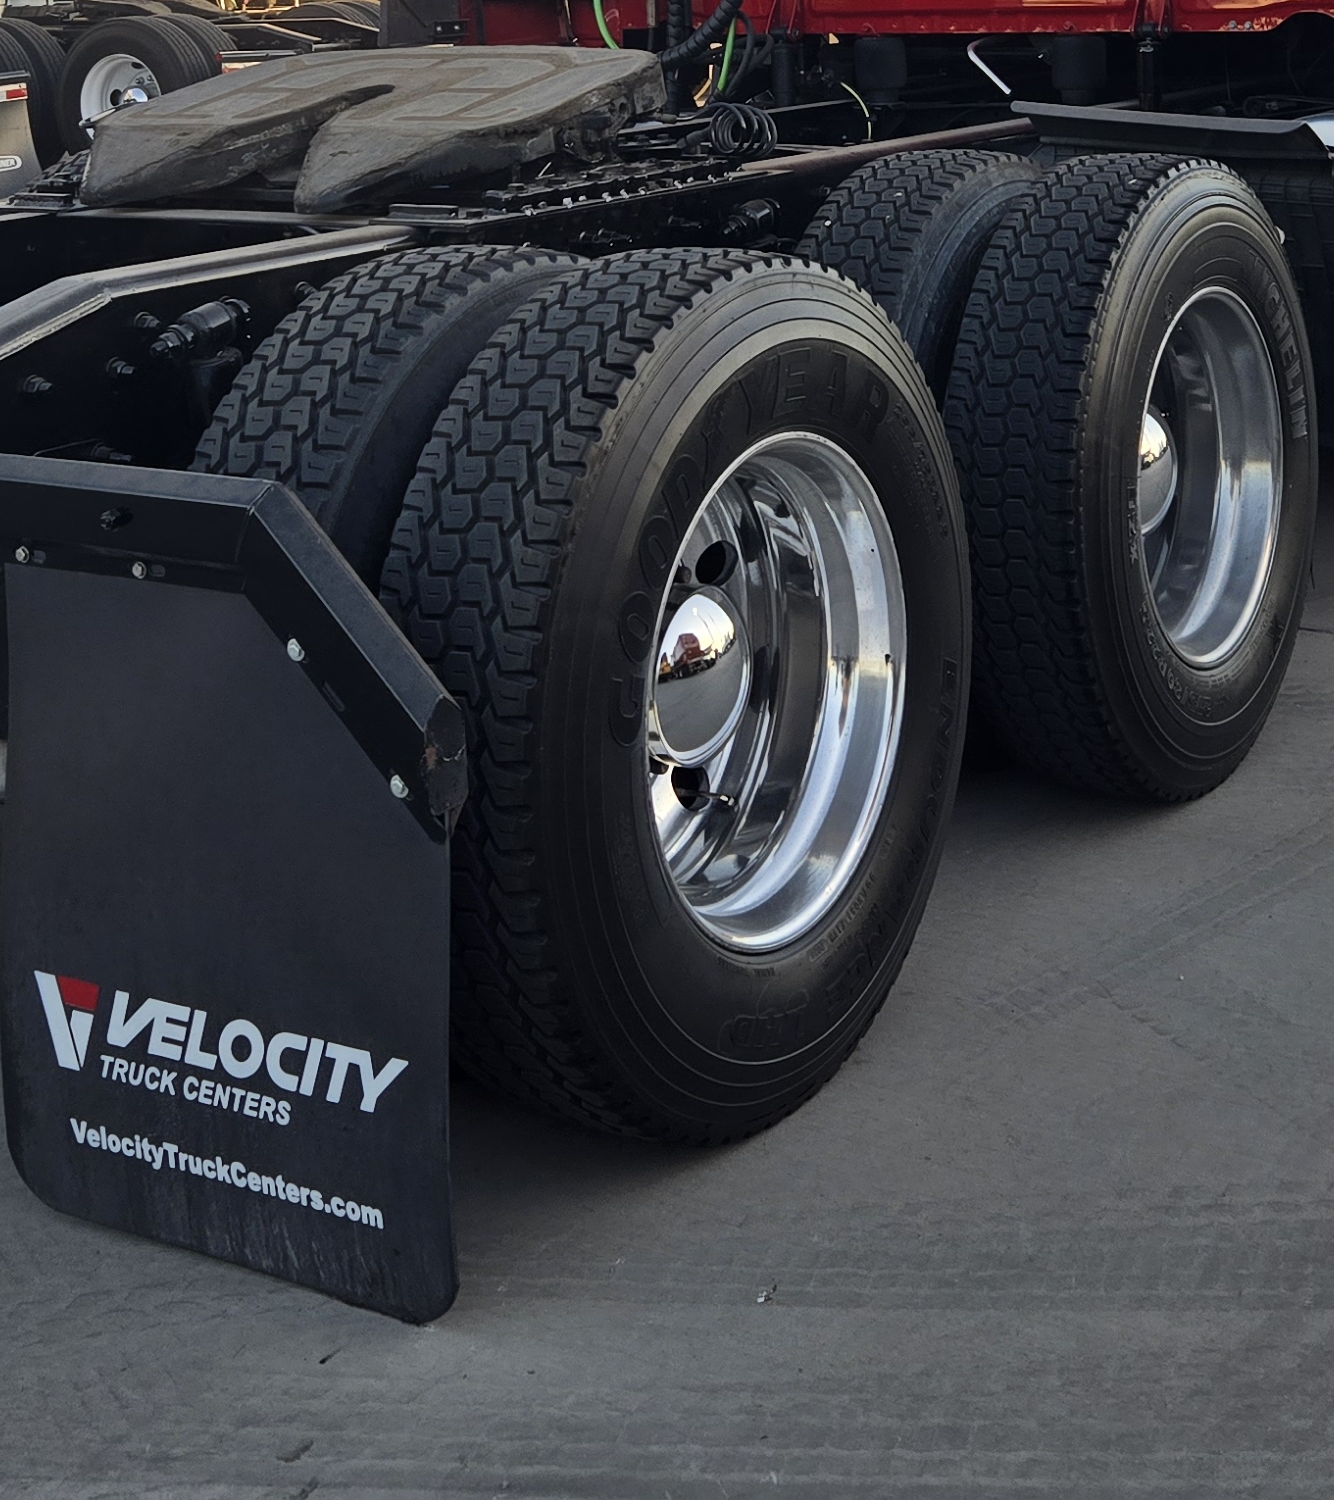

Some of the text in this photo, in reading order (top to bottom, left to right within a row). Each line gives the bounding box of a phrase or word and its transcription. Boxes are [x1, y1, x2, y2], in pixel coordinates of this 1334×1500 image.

[99, 1054, 291, 1127] TRUCK CENTERS
[106, 989, 409, 1113] VELOCITY
[69, 1117, 386, 1230] VelocityTruckCenters.com
